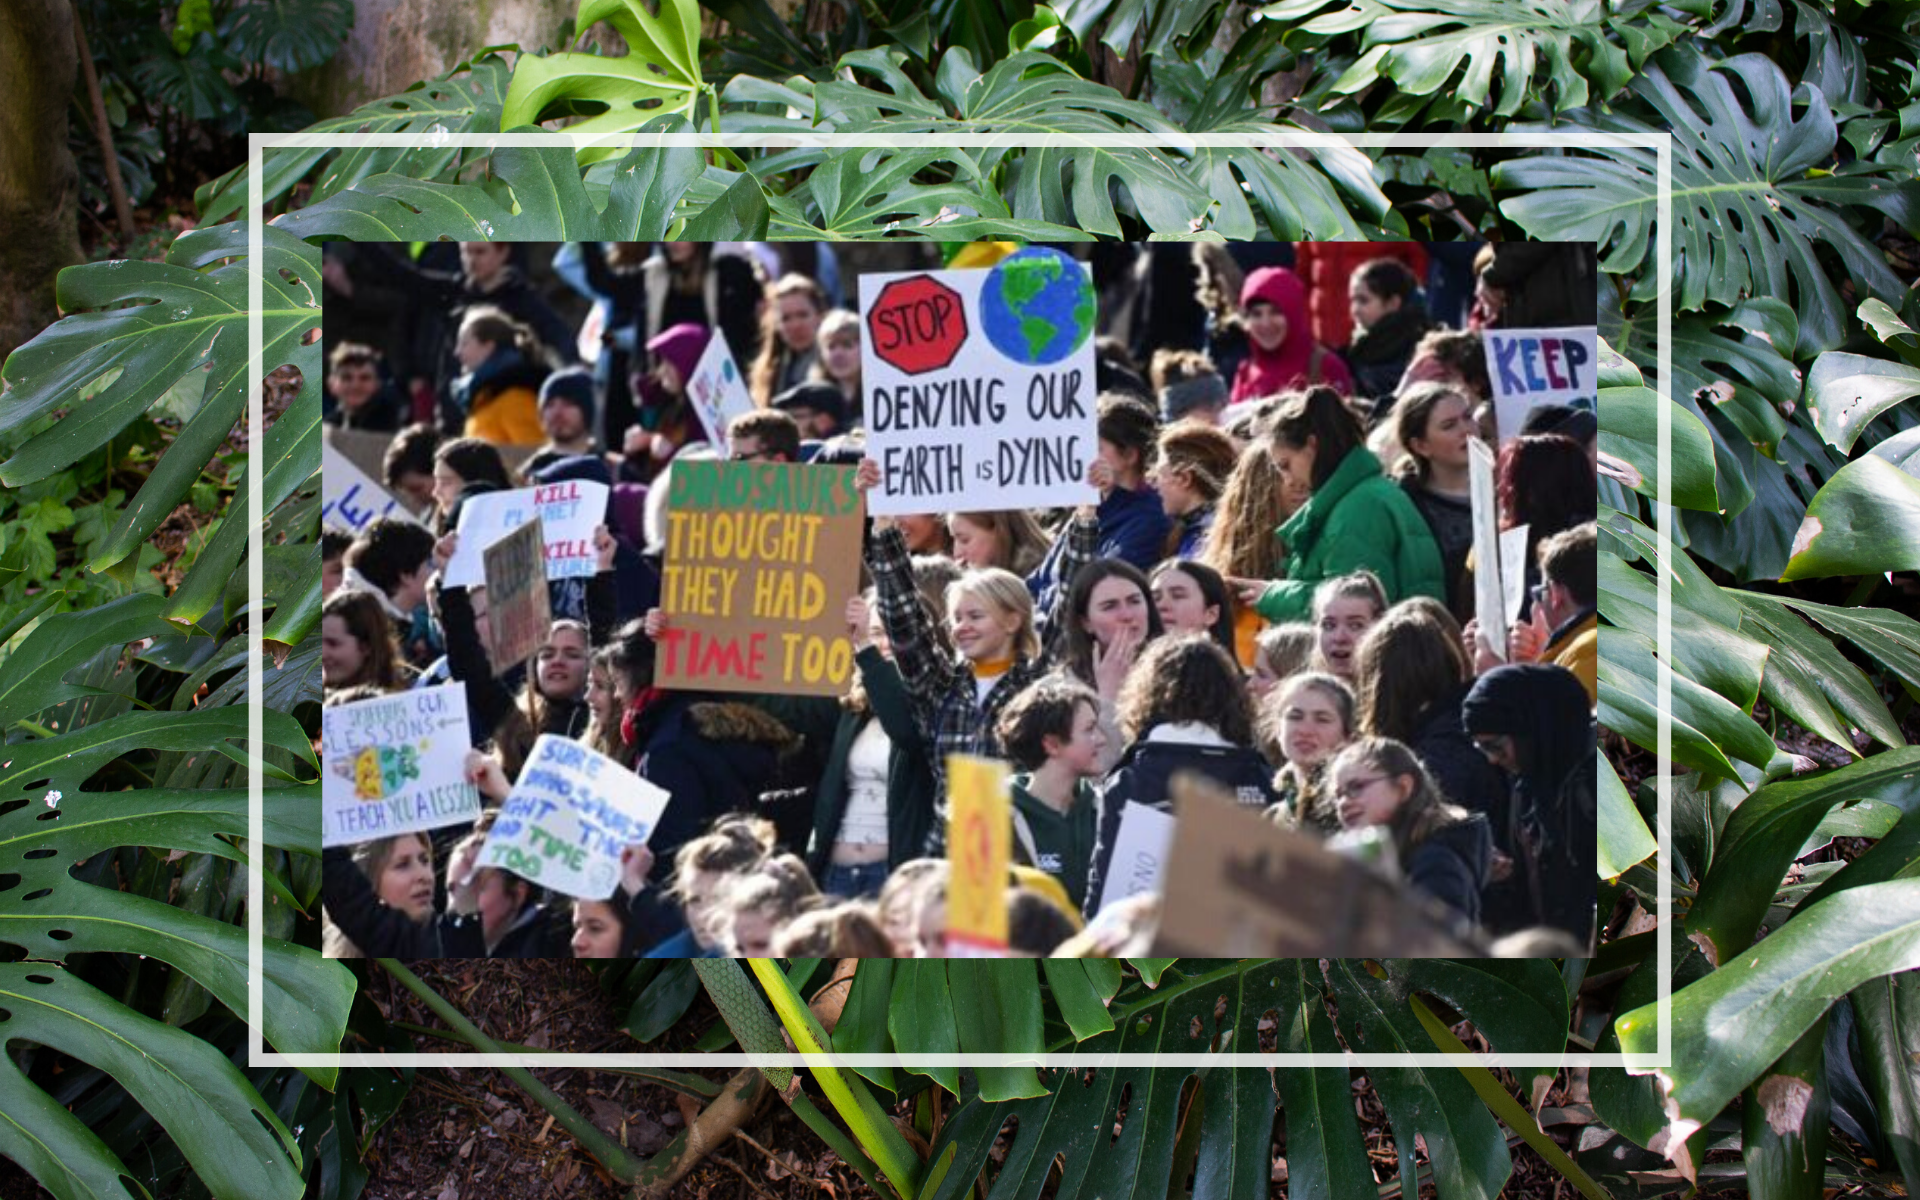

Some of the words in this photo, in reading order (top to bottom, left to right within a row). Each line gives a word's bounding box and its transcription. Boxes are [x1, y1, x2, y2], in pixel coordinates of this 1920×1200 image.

[878, 293, 953, 350] STOP
[1491, 336, 1589, 396] KEEP
[872, 377, 1007, 433] DENYING
[1026, 368, 1086, 421] OUR
[668, 460, 859, 516] DINOSAURS
[884, 443, 965, 497] EARTH
[997, 435, 1084, 487] DYING
[503, 500, 581, 528] PLNET
[534, 482, 582, 505] KILL
[667, 511, 823, 565] THOUGHT
[663, 565, 738, 618] THEY
[753, 568, 826, 622] HAD
[660, 627, 768, 681] TIME
[781, 632, 854, 685] TOO
[330, 717, 435, 754] LESSONS
[540, 739, 604, 780] SURE
[336, 801, 387, 832] TEACH
[416, 791, 430, 820] A
[490, 844, 543, 878] TOO
[529, 824, 588, 872] TIME
